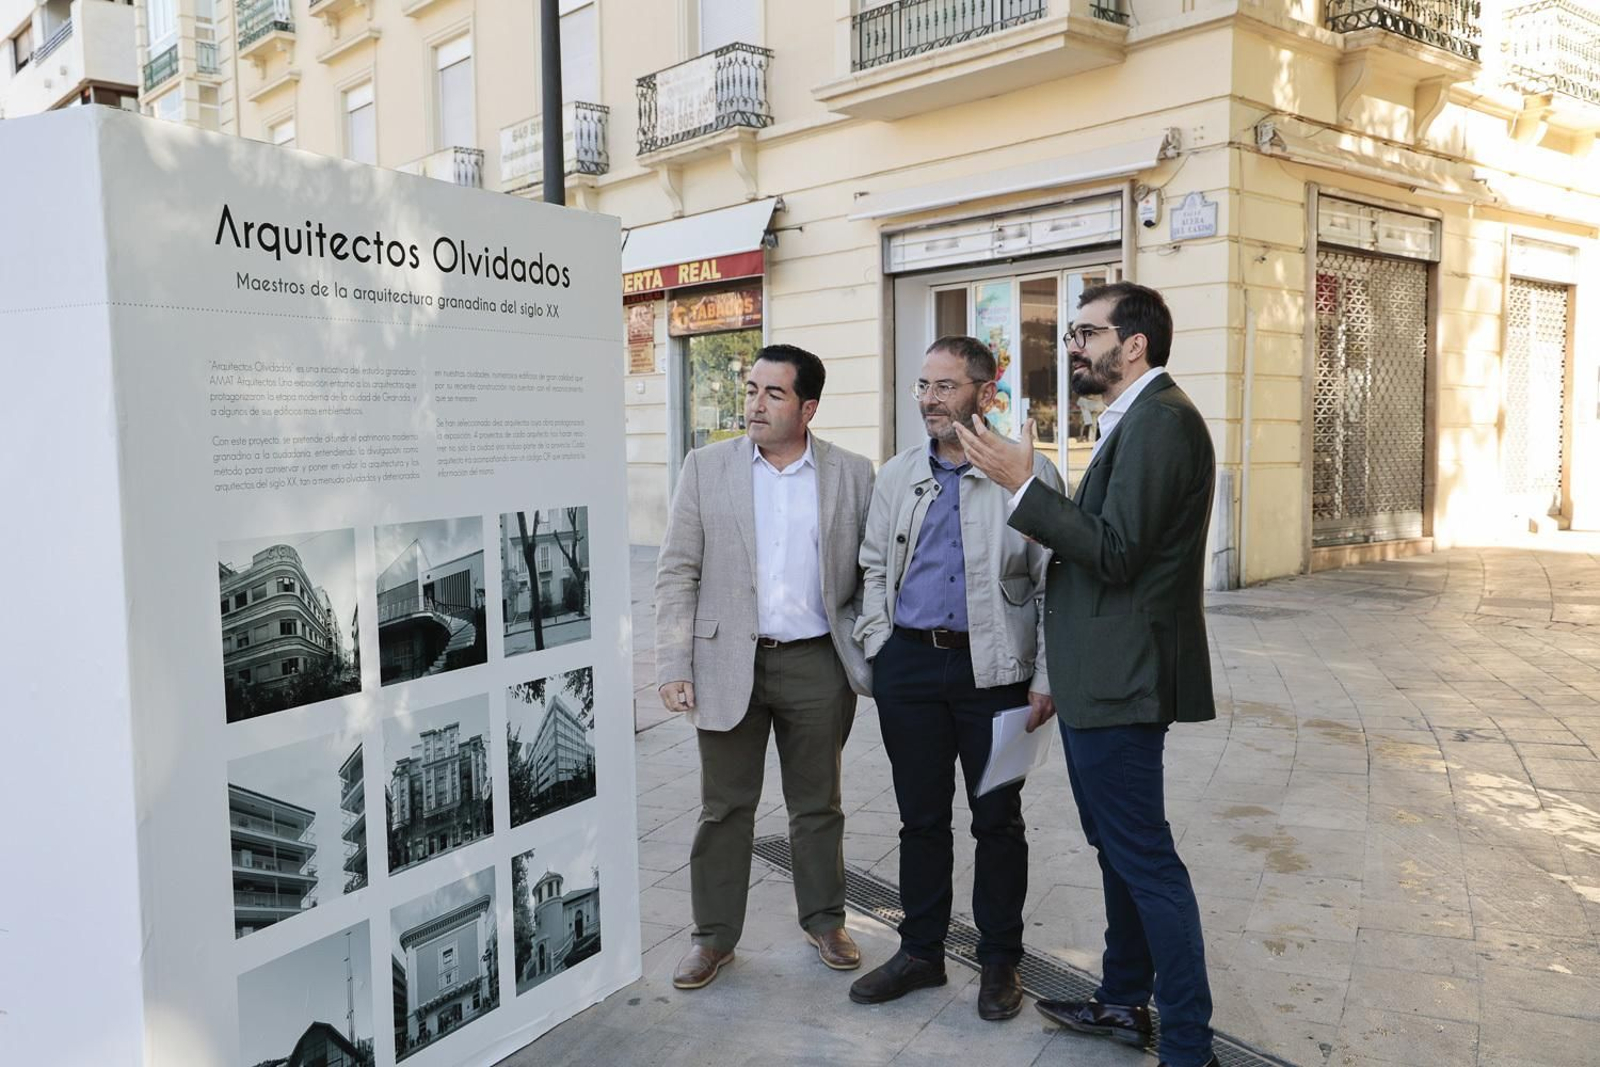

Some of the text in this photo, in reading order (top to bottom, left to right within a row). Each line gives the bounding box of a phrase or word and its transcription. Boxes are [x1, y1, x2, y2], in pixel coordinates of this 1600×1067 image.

[216, 204, 570, 288] Arquitectos Olvidados
[236, 272, 560, 318] Maestros de la arquitectura granadina del siglo XX
[622, 259, 722, 293] ERTA REAL
[690, 296, 753, 320] TABACOS
